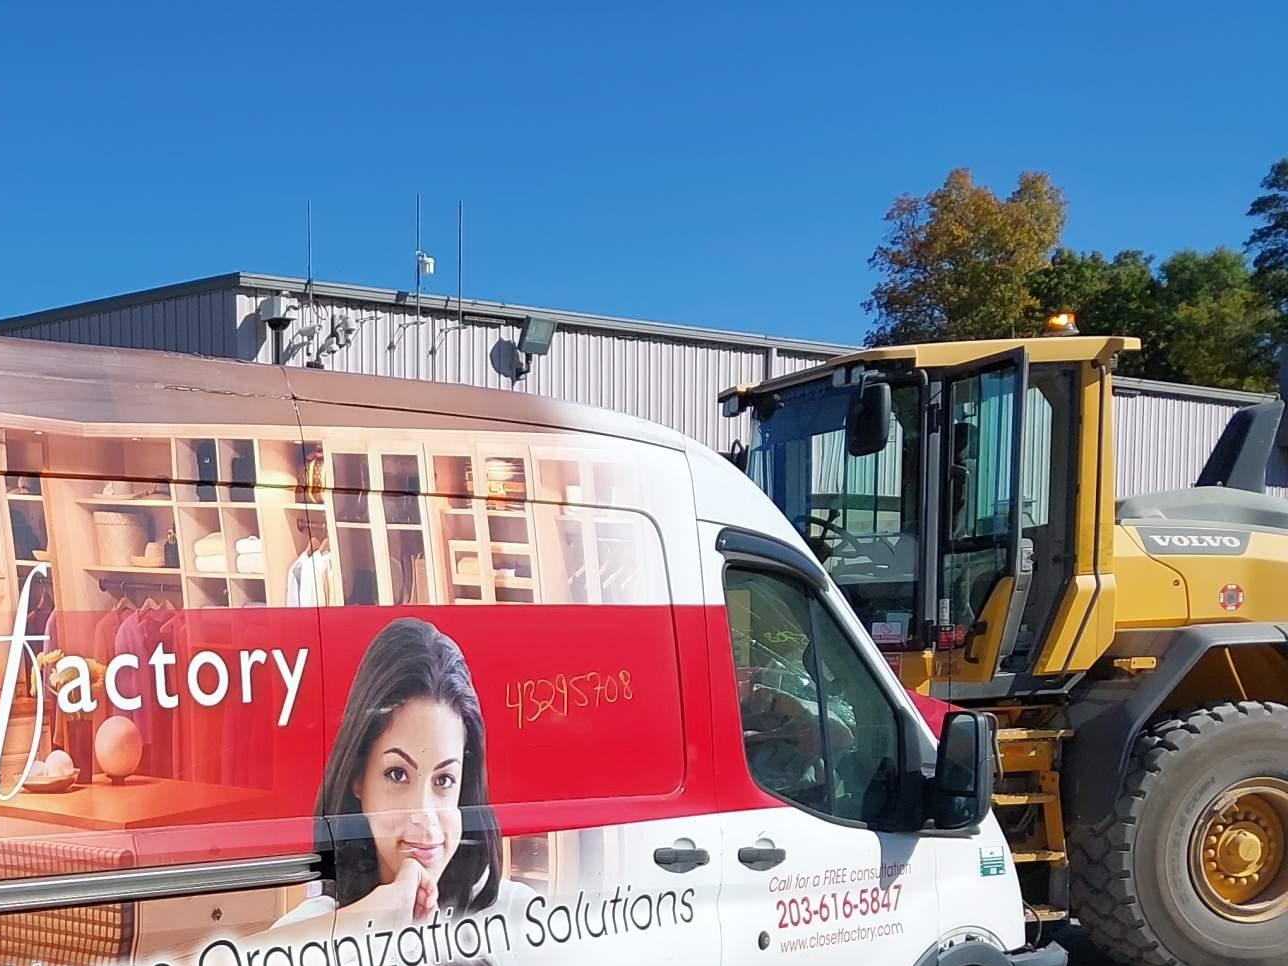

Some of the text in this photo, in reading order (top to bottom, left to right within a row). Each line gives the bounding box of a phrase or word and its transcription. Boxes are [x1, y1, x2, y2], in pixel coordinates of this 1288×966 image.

[1148, 535, 1241, 548] VOLVO
[505, 669, 633, 729] 43295708
[768, 861, 912, 893] Call for a FREE consultation
[525, 885, 696, 948] Solutions
[776, 884, 903, 929] 203-616-5847
[780, 921, 904, 953] www.closetfactory.com
